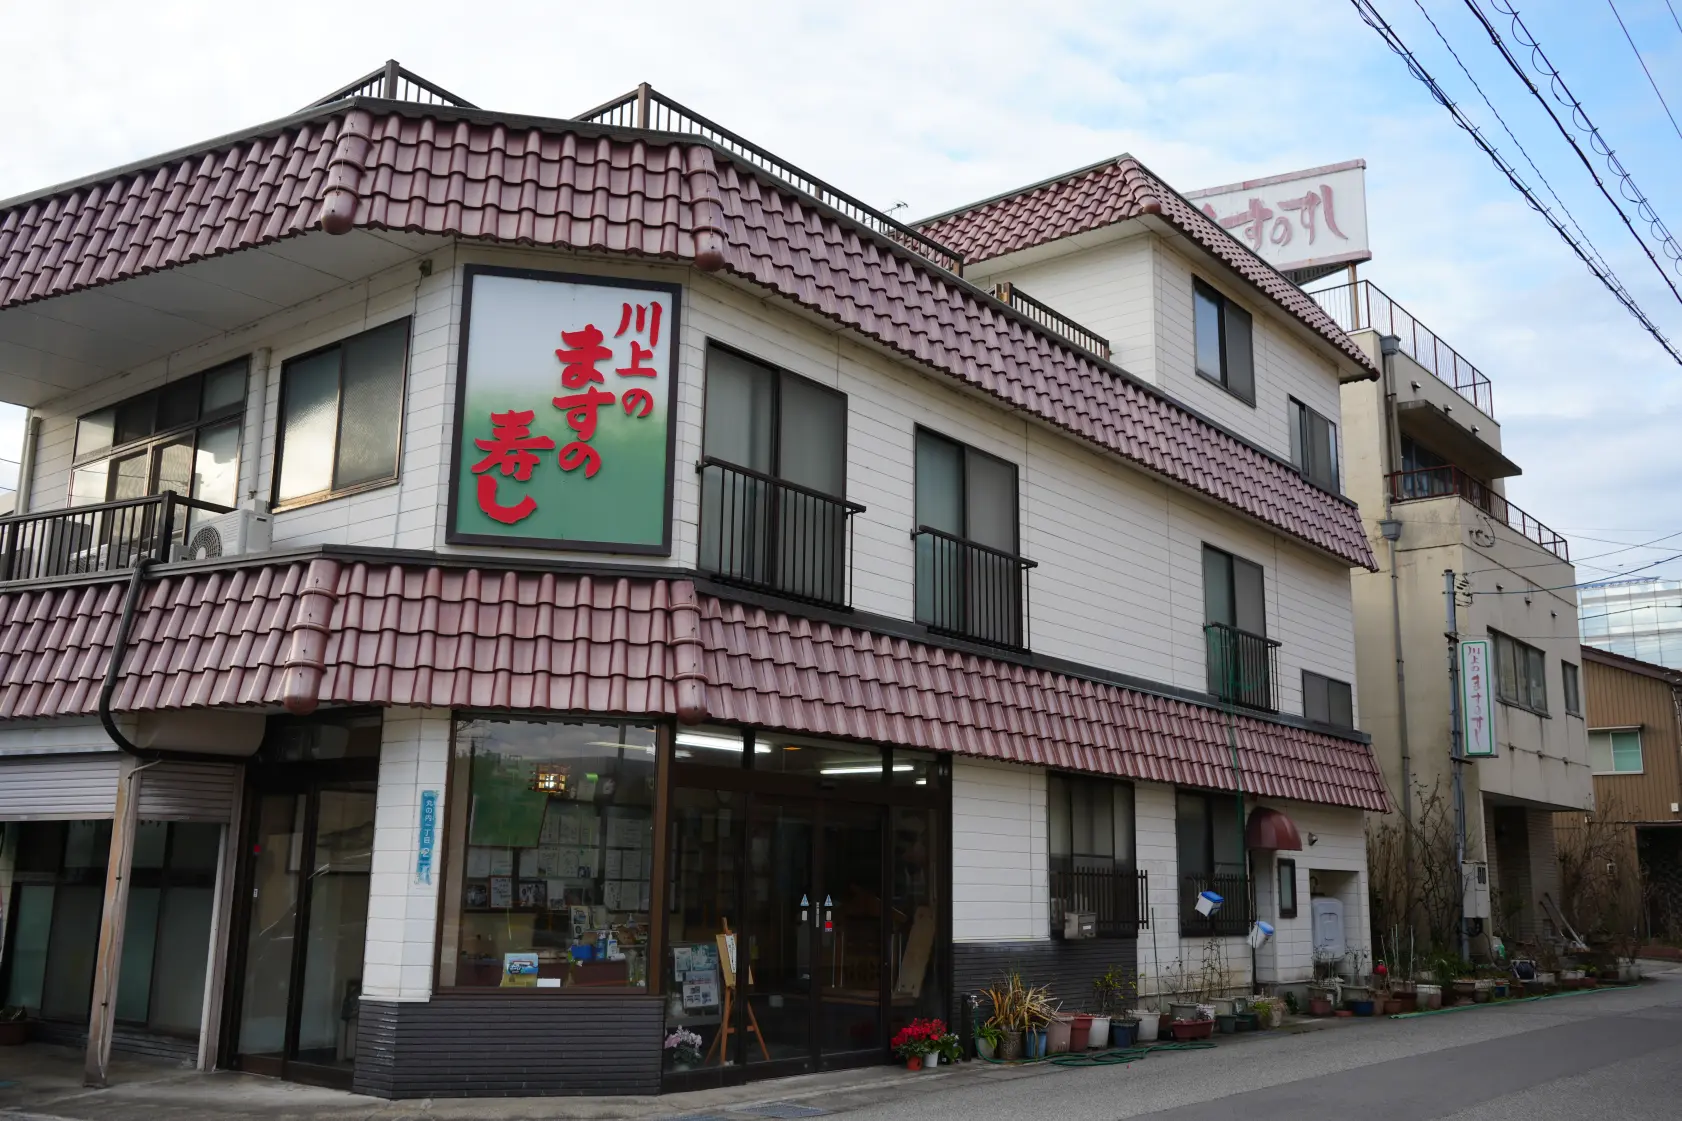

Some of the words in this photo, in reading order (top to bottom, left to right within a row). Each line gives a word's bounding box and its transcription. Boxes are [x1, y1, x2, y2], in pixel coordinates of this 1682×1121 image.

[1202, 184, 1349, 251] すのすし
[552, 324, 616, 479] ますの
[615, 301, 663, 418] 川上の
[471, 409, 555, 524] 寿し
